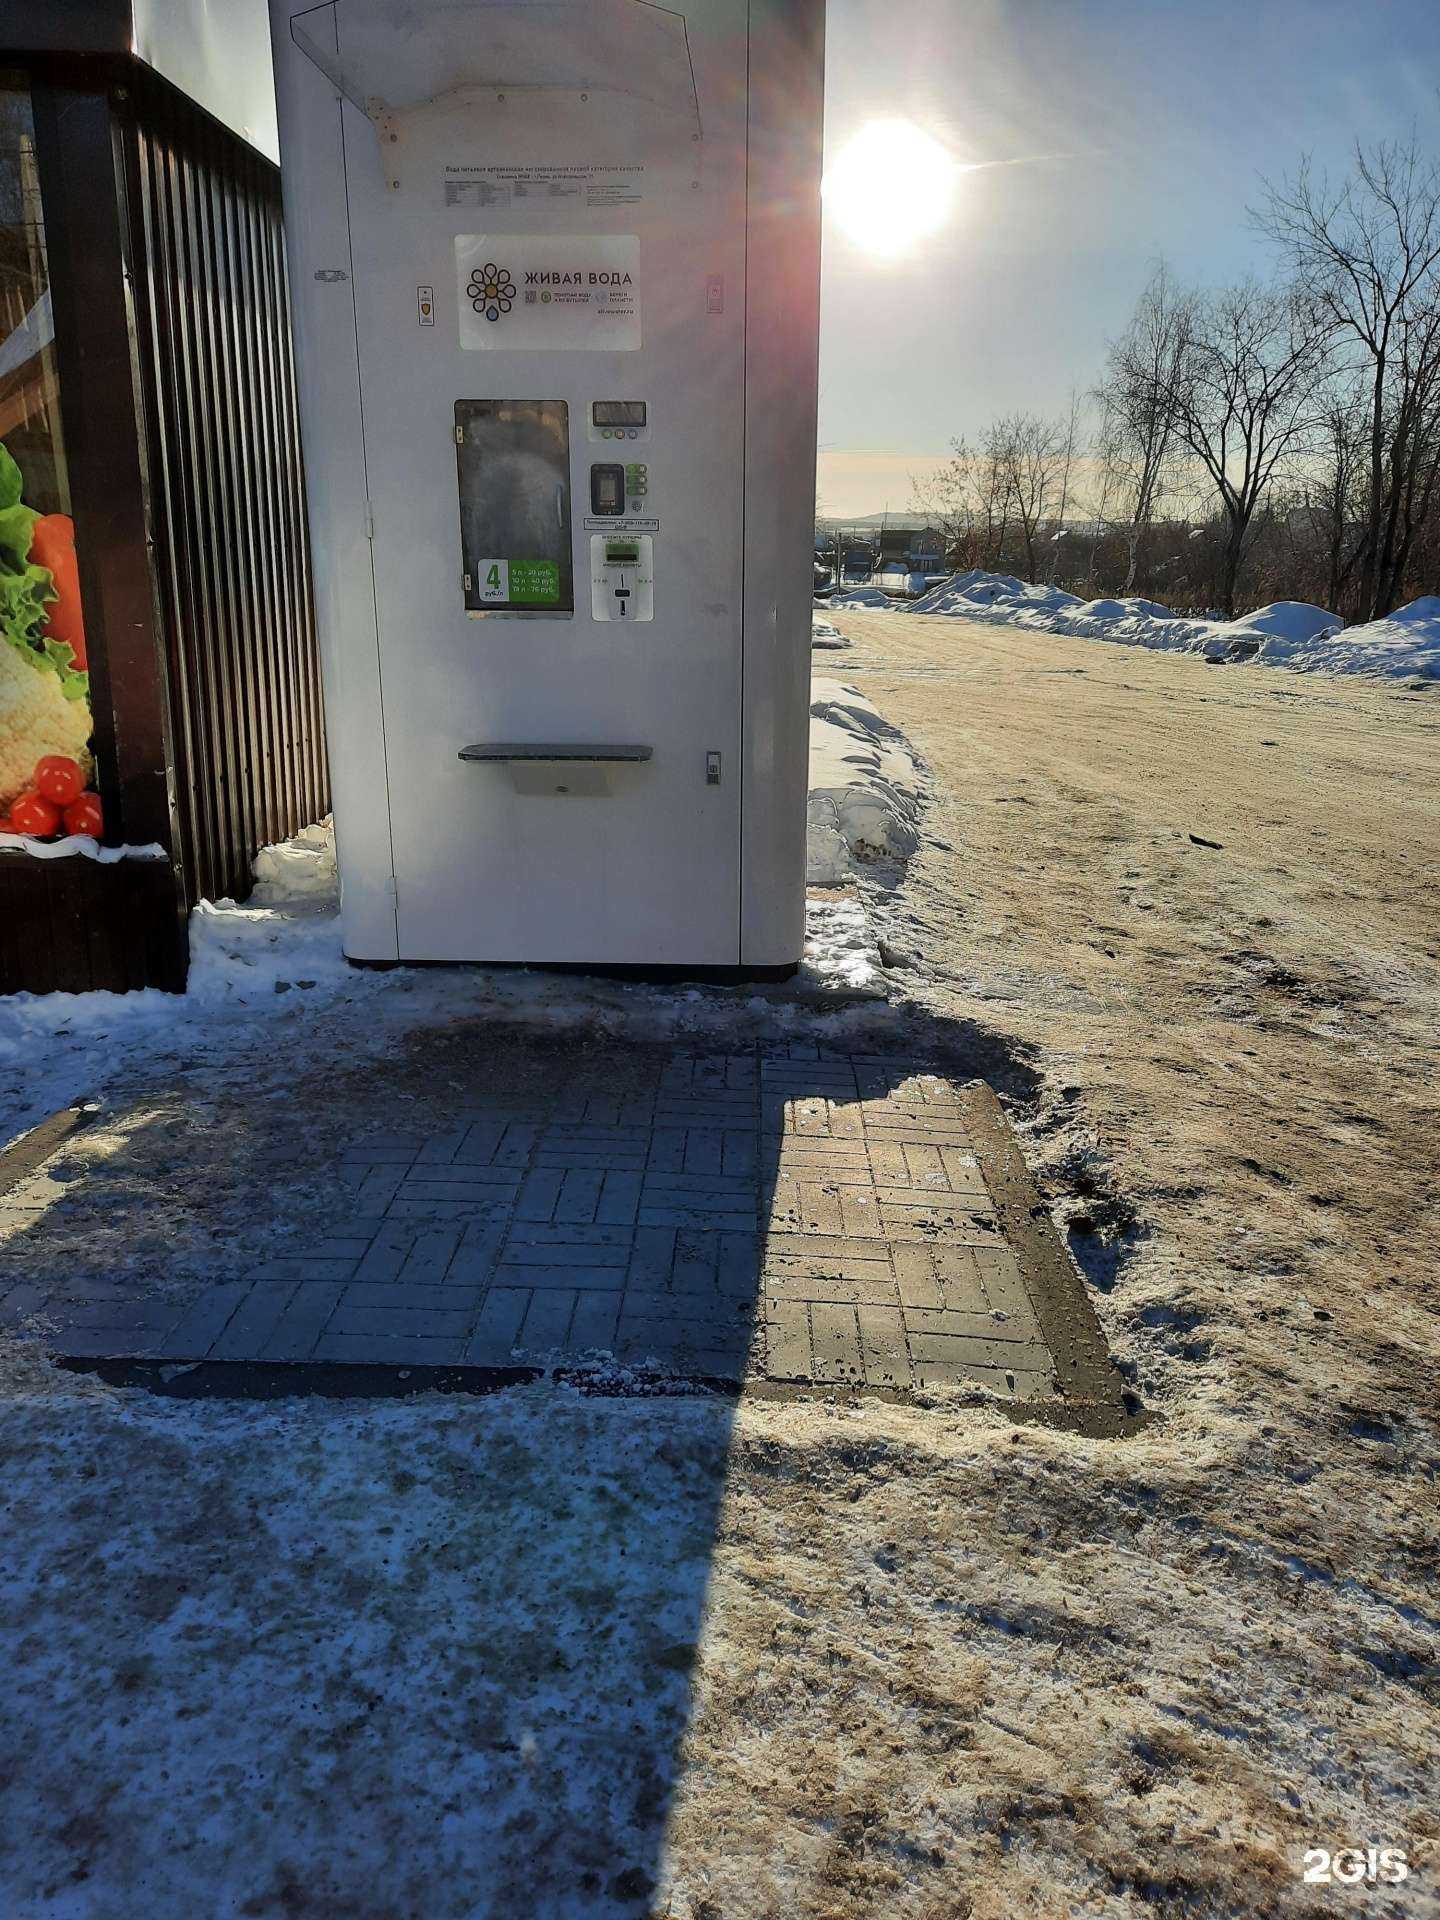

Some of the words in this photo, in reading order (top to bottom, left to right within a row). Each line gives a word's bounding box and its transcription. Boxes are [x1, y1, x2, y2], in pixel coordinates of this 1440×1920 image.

[525, 272, 582, 284] ЖИВАЯ
[588, 272, 632, 286] ВОДА
[487, 564, 501, 590] 4
